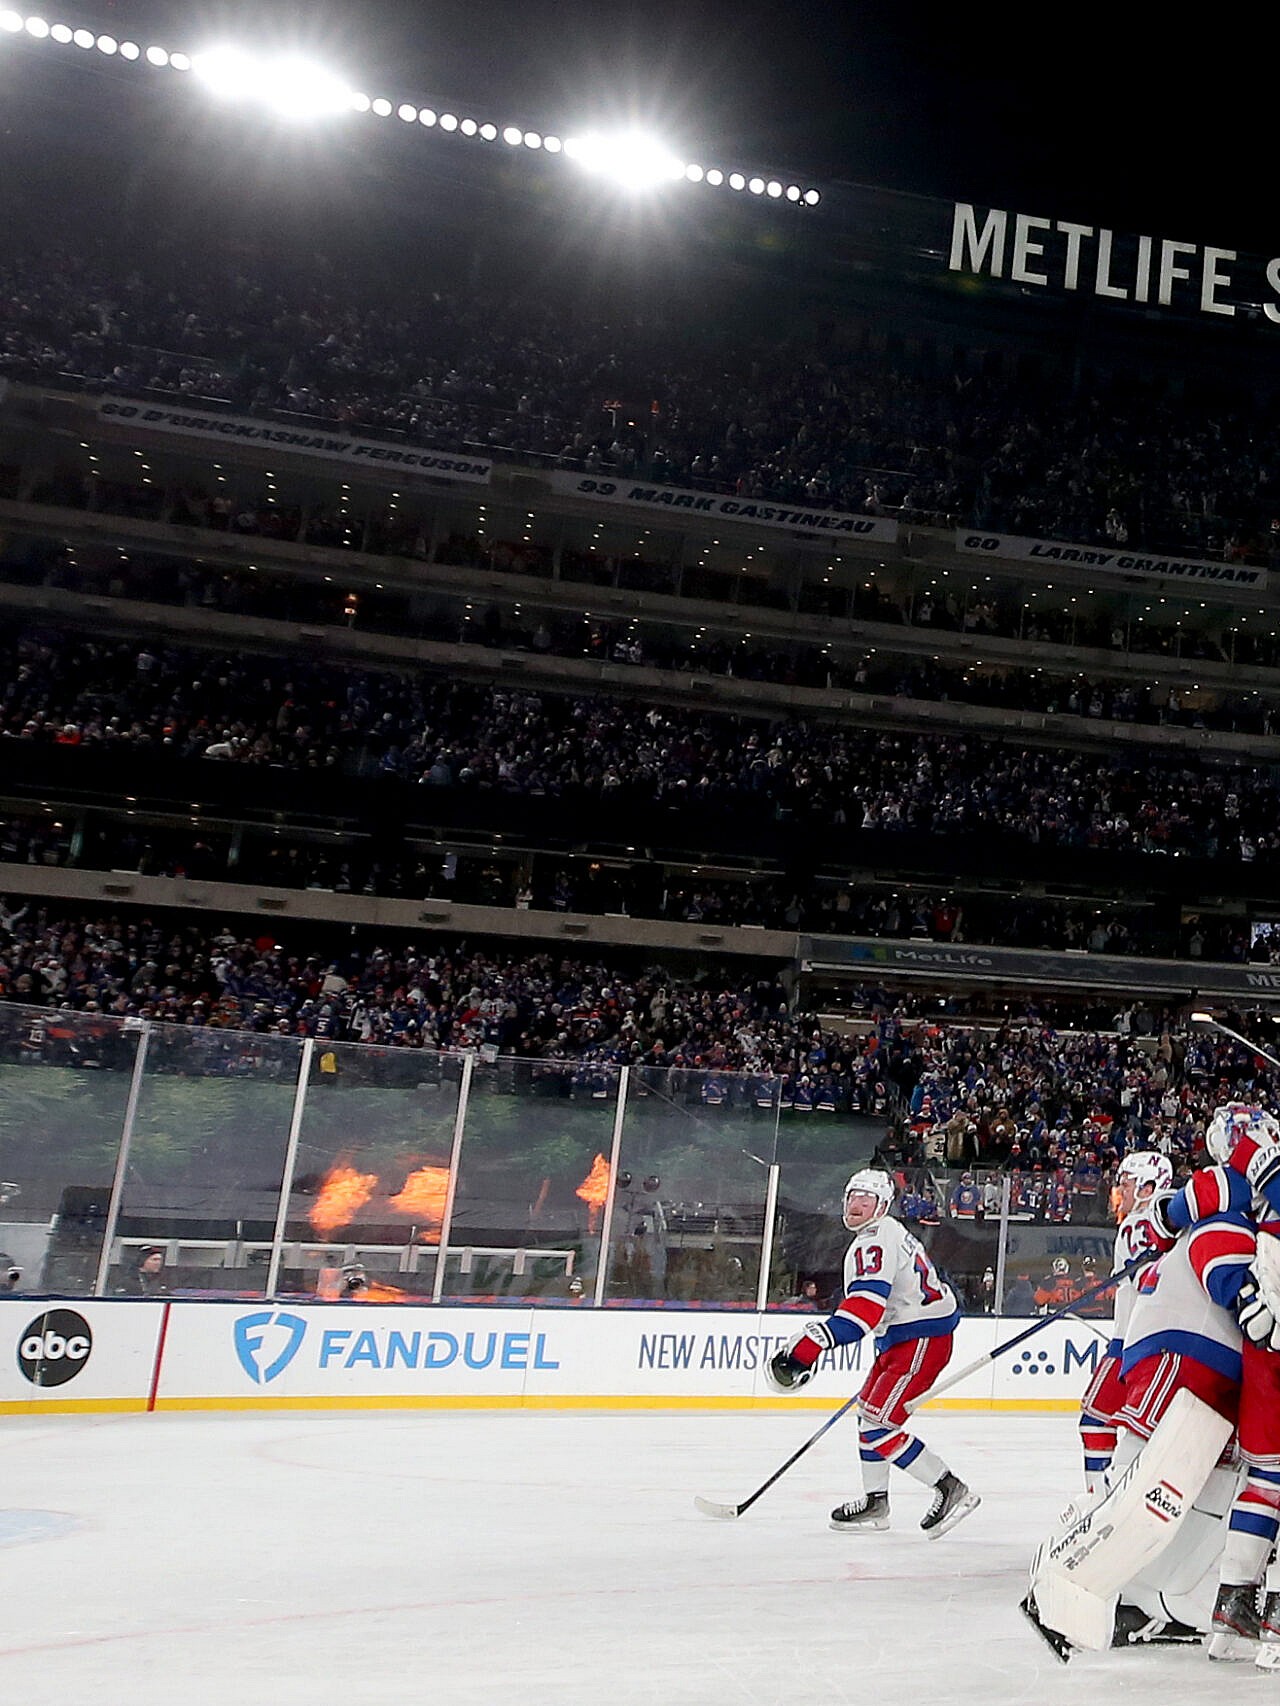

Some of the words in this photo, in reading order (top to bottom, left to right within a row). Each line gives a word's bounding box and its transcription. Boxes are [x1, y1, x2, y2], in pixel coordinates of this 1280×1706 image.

[949, 203, 1237, 316] METLIFE
[352, 445, 489, 476] FERGUSON
[628, 487, 711, 512] MARK
[720, 502, 875, 534] GASTINEAU
[1030, 545, 1115, 566] LARRY
[1116, 556, 1259, 583] GRANTHAM
[895, 949, 993, 966] MetLife
[854, 1245, 884, 1276] 13
[20, 1330, 91, 1361] abc
[318, 1330, 560, 1370] FANDUEL
[638, 1334, 696, 1369] NEW
[700, 1335, 862, 1371] AMSTAM
